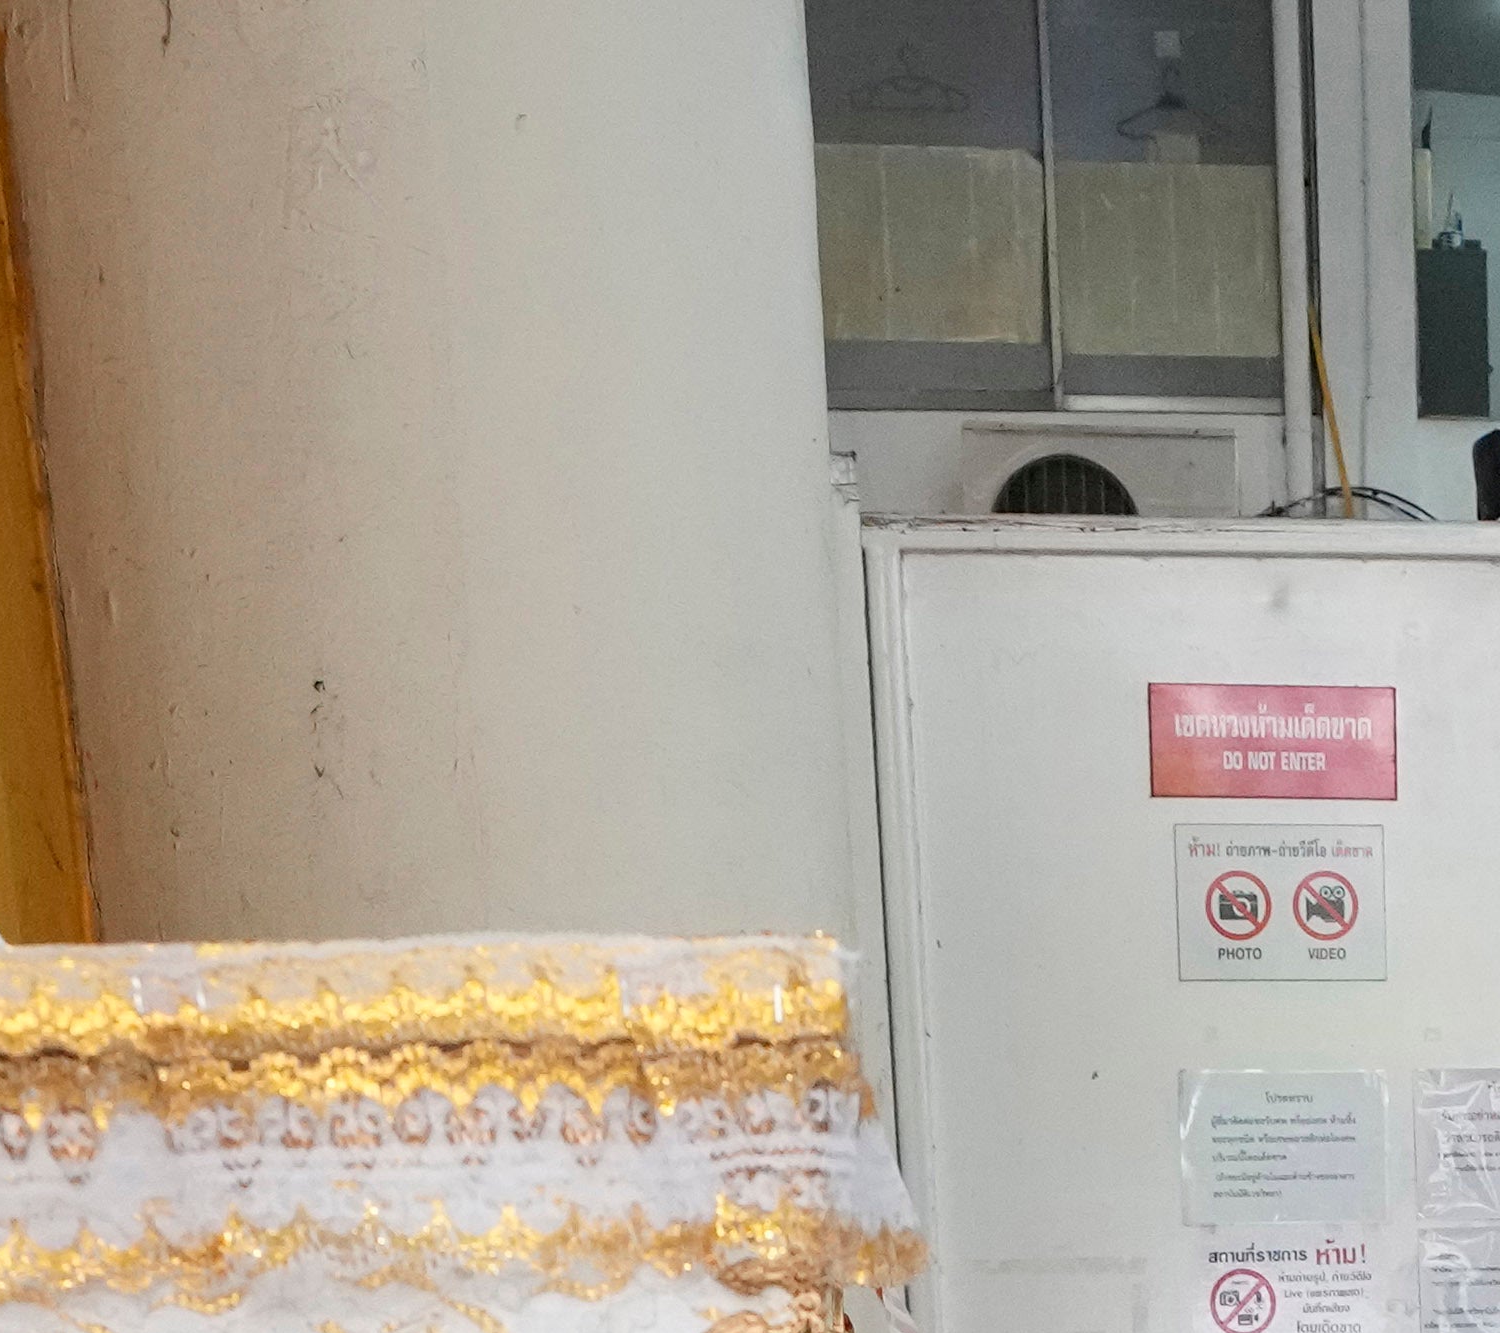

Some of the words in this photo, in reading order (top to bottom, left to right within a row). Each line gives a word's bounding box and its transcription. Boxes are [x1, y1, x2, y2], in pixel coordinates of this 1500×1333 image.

[1174, 703, 1372, 741] เขตหวงห้ามเด็ดขาด
[1223, 751, 1242, 771] DO
[1248, 751, 1276, 771] NOT
[1281, 751, 1326, 771] ENTER
[1218, 947, 1262, 960] PHOTO
[1308, 947, 1347, 960] VIDEO
[1208, 1242, 1308, 1264] สถานที่ราชการ
